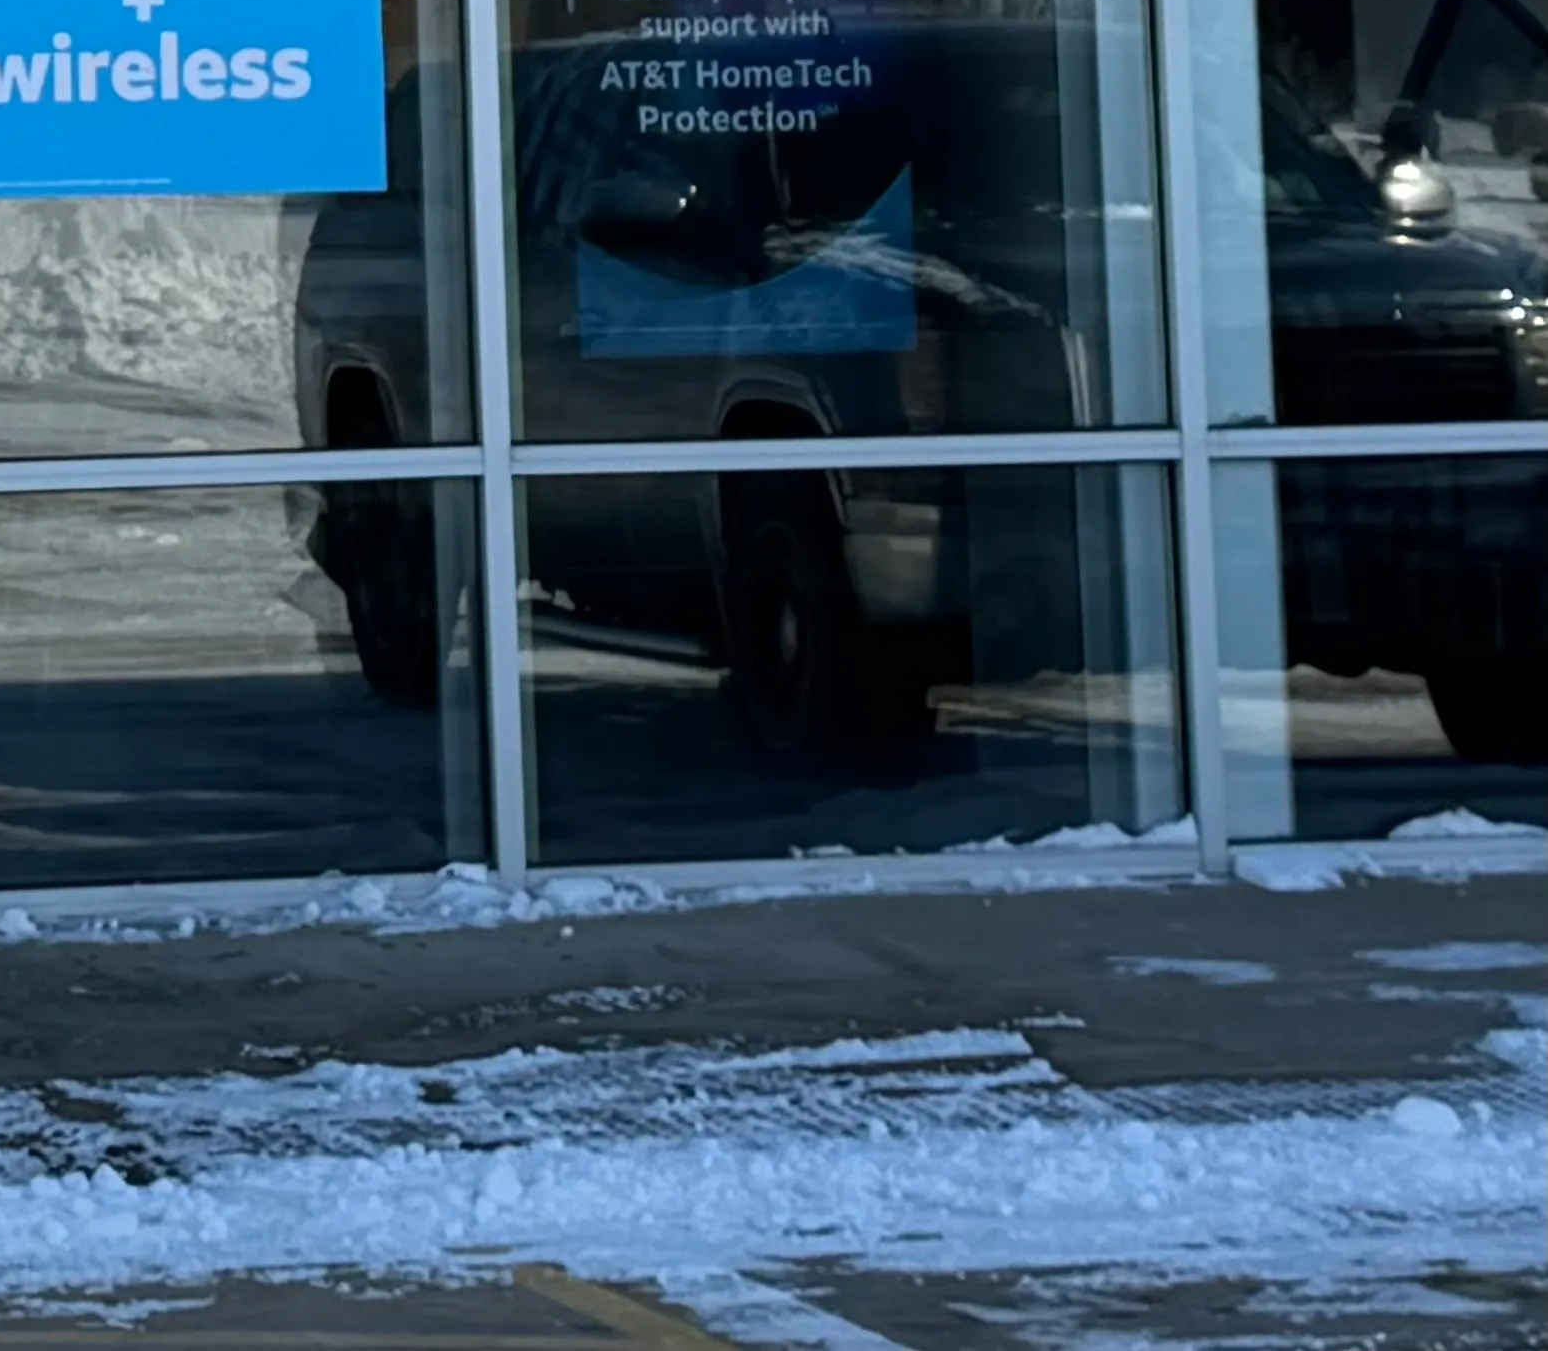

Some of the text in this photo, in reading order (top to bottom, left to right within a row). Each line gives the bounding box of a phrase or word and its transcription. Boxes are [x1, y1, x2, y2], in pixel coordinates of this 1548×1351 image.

[640, 10, 829, 43] support with
[600, 57, 872, 90] AT&T HomeTech
